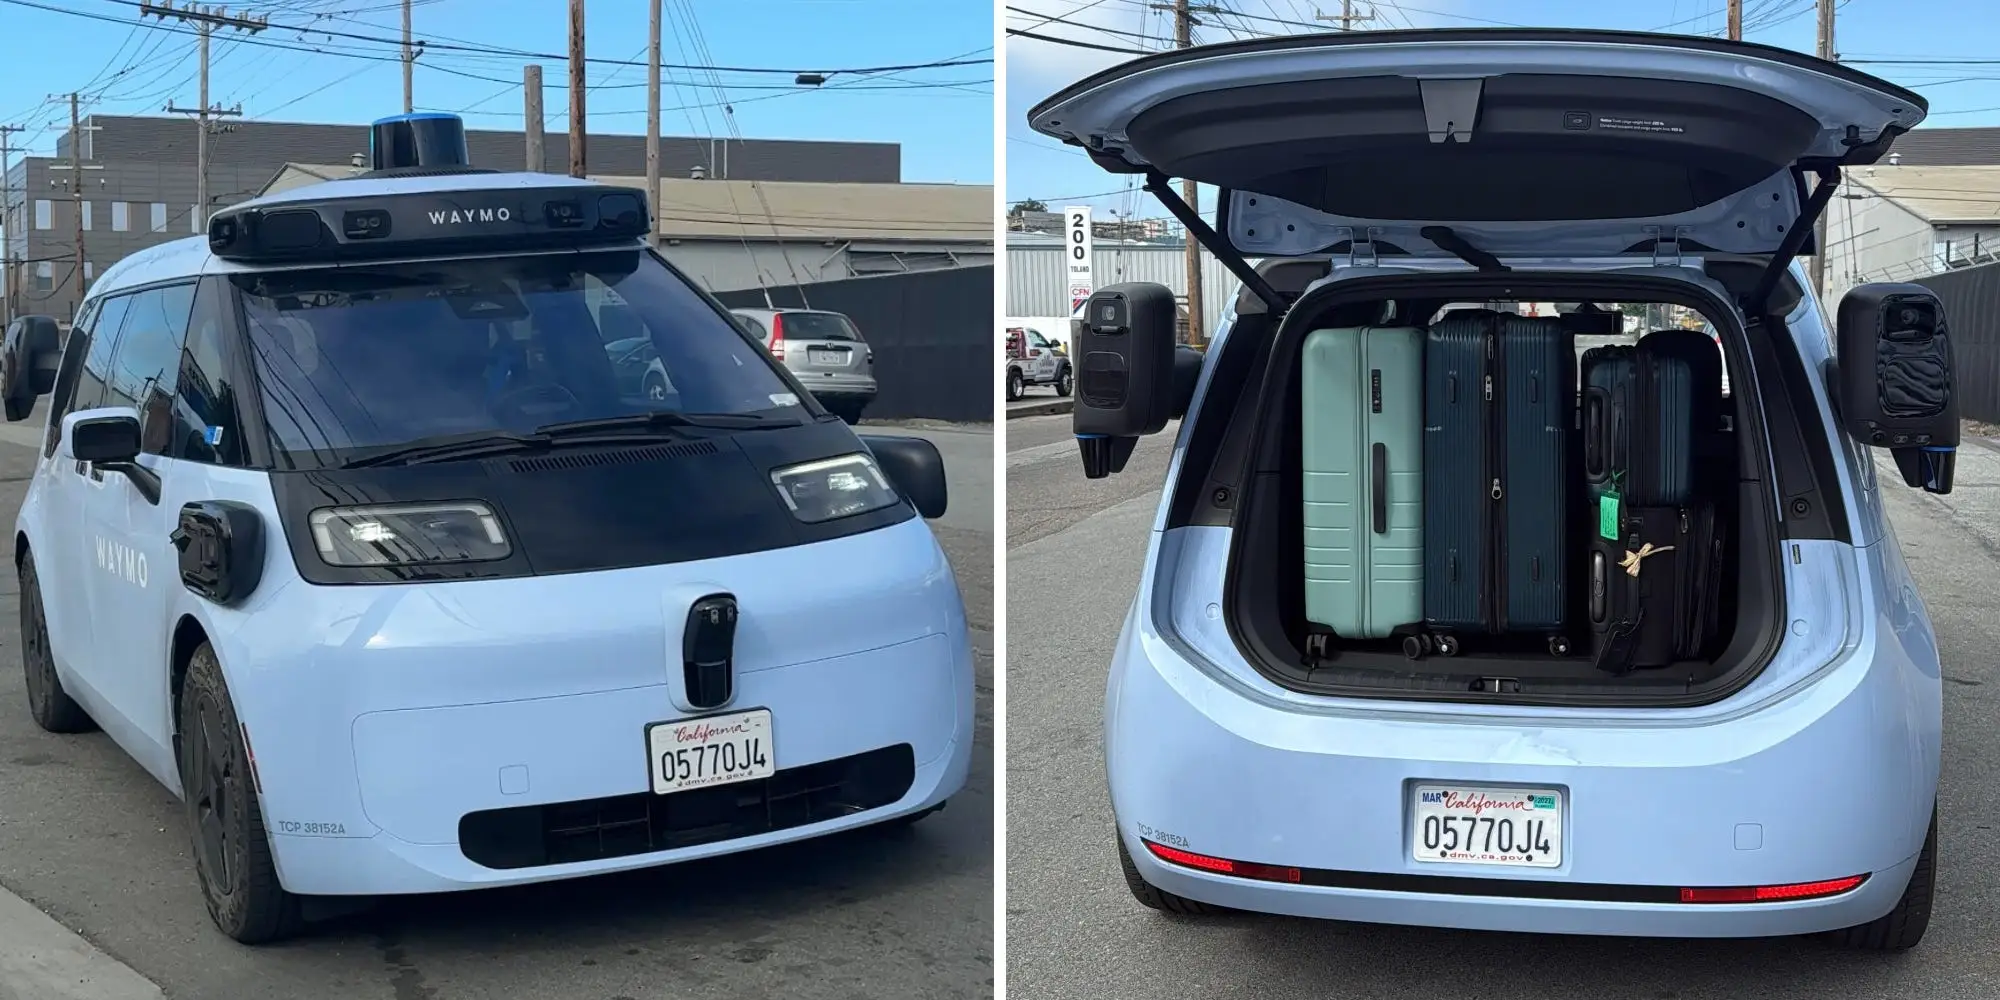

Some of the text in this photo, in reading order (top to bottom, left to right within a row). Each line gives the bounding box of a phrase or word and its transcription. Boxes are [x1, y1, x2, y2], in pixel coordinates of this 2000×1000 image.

[428, 207, 510, 225] WAYMO
[1072, 213, 1085, 260] 200
[1072, 288, 1090, 296] CFN
[95, 535, 148, 588] WAYMO
[677, 721, 750, 743] California
[661, 737, 766, 782] 05770J4
[685, 772, 746, 786] dmv.ca.gov
[1422, 792, 1442, 803] MAR
[1445, 791, 1534, 815] California
[279, 821, 346, 834] TCP 38152A
[1137, 821, 1190, 848] TCP 38152A
[1424, 815, 1550, 855] 05770J4
[1449, 852, 1524, 862] dmv.ca.gov
